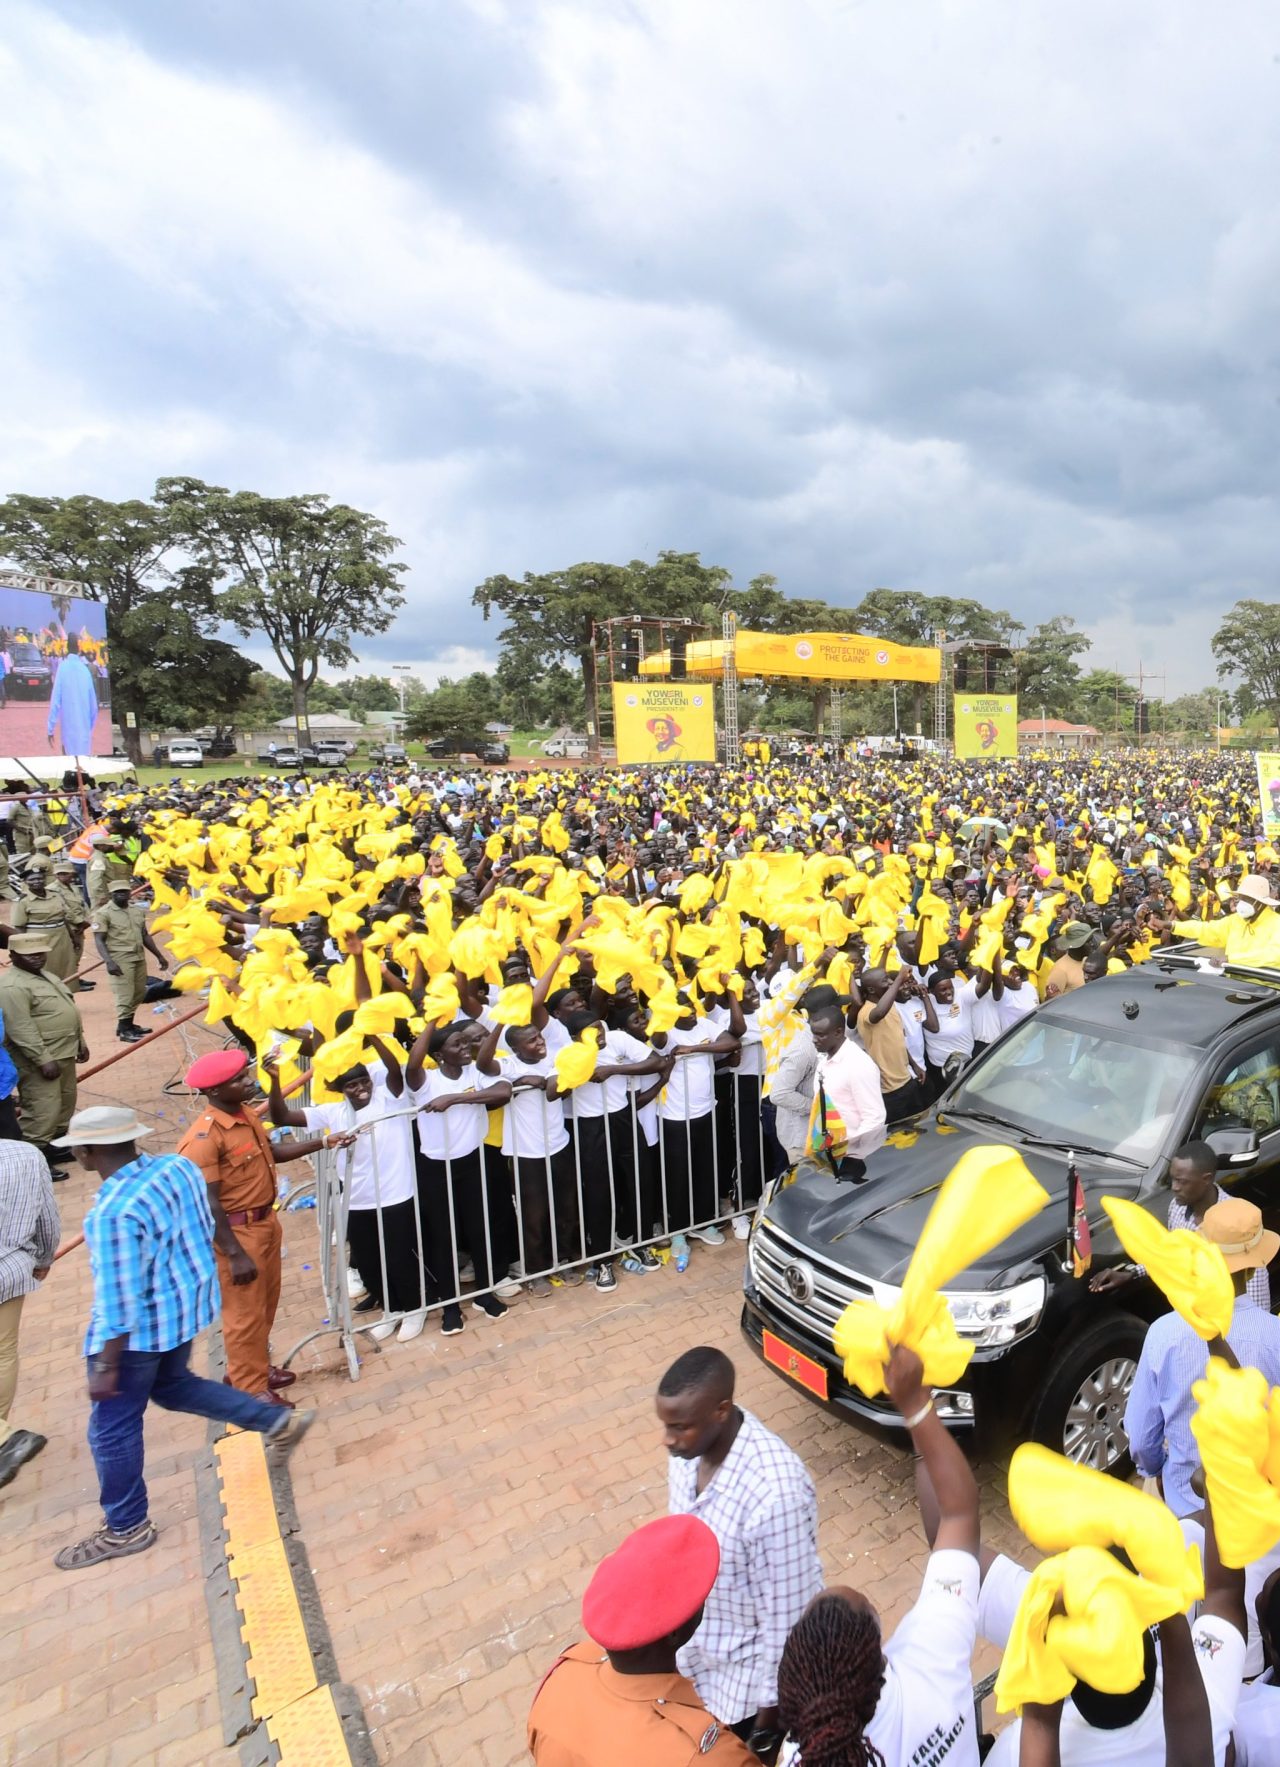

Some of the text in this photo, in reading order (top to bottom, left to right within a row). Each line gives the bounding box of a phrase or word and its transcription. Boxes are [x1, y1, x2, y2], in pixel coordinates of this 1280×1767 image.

[819, 645, 870, 657] PROTECTING
[825, 653, 866, 664] THE GAINS
[646, 689, 683, 698] YOWERI
[641, 697, 689, 706] MUSEVENI
[912, 1723, 946, 1766] FACE
